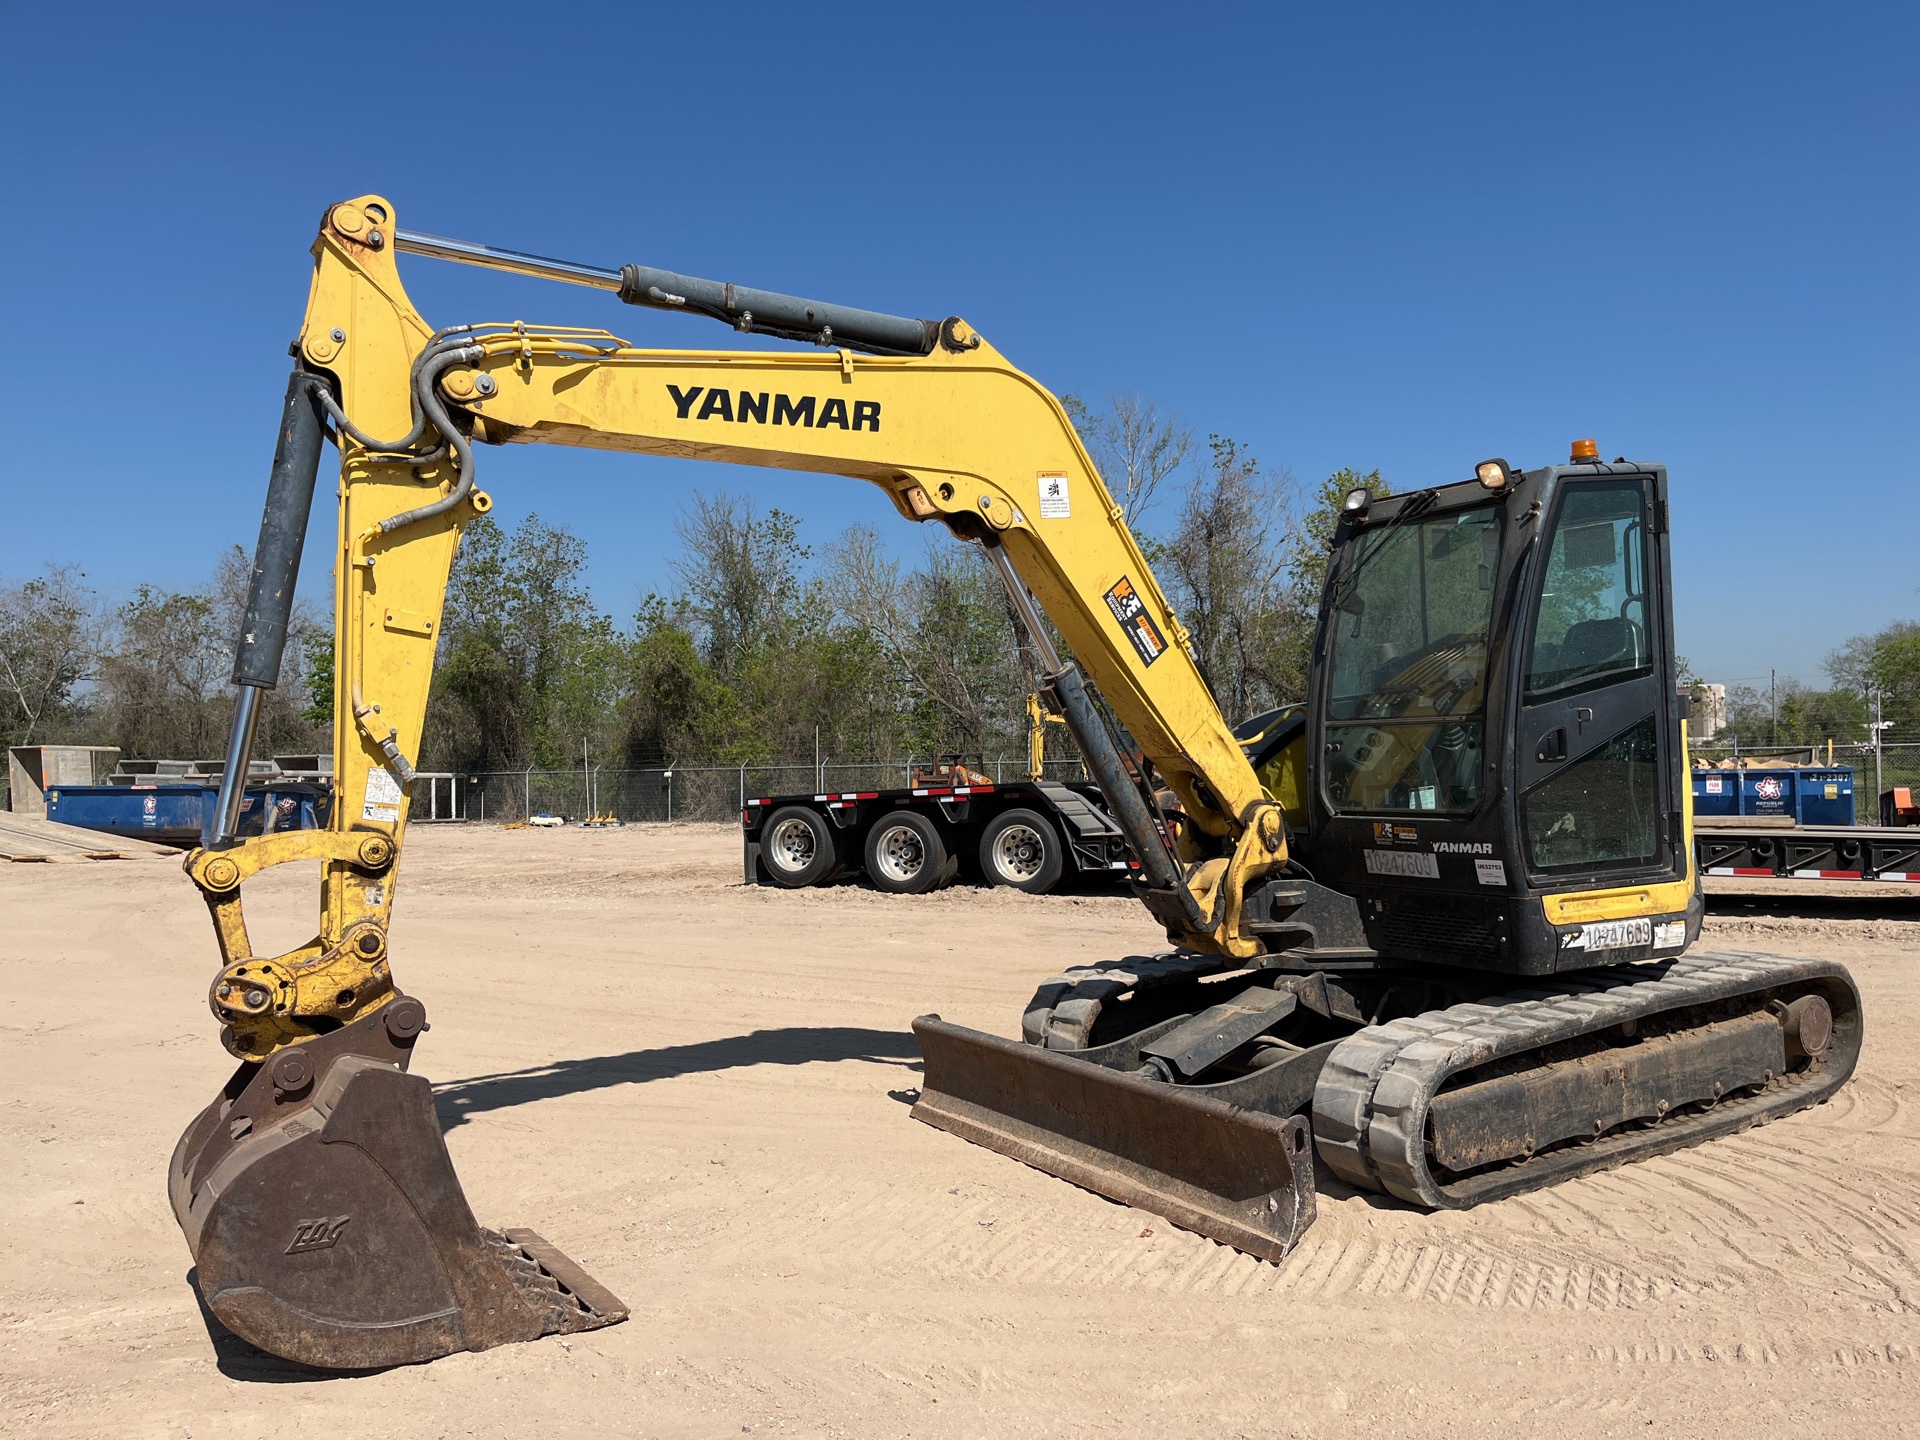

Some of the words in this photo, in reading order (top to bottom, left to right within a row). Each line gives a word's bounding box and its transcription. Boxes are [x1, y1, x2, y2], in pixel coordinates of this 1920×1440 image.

[666, 384, 881, 432] YANMAR
[1111, 577, 1141, 618] H&E
[968, 771, 983, 782] CASE
[1430, 841, 1493, 855] YANMAR
[1366, 852, 1432, 876] 10247609
[1586, 921, 1650, 948] 10247609
